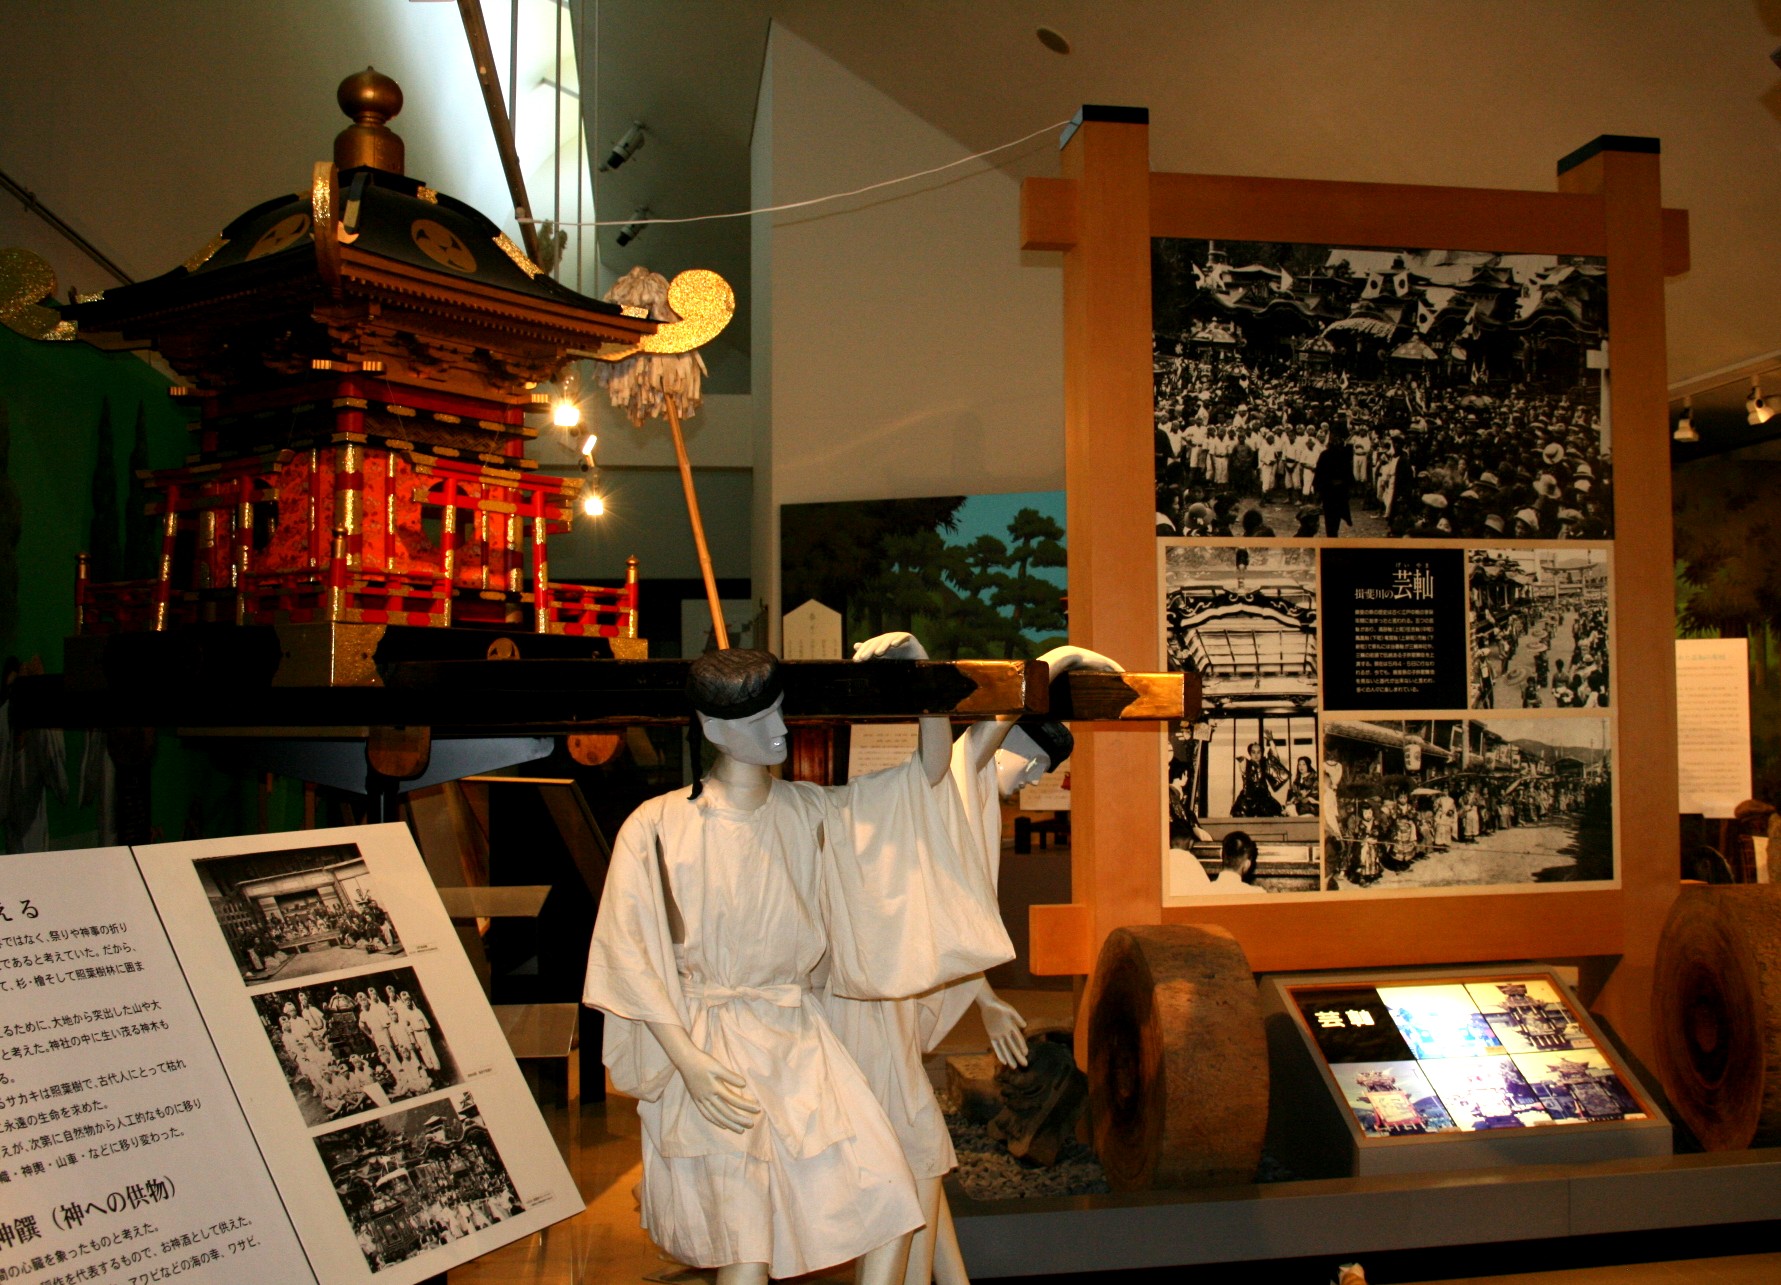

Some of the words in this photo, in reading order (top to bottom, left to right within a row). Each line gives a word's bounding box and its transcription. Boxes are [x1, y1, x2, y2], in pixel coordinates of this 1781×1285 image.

[0, 921, 128, 949] ではなく、祭りや神事の折り
[0, 941, 137, 972] であると考えていた。だから、
[0, 999, 162, 1038] るために、大地から突出した山や大
